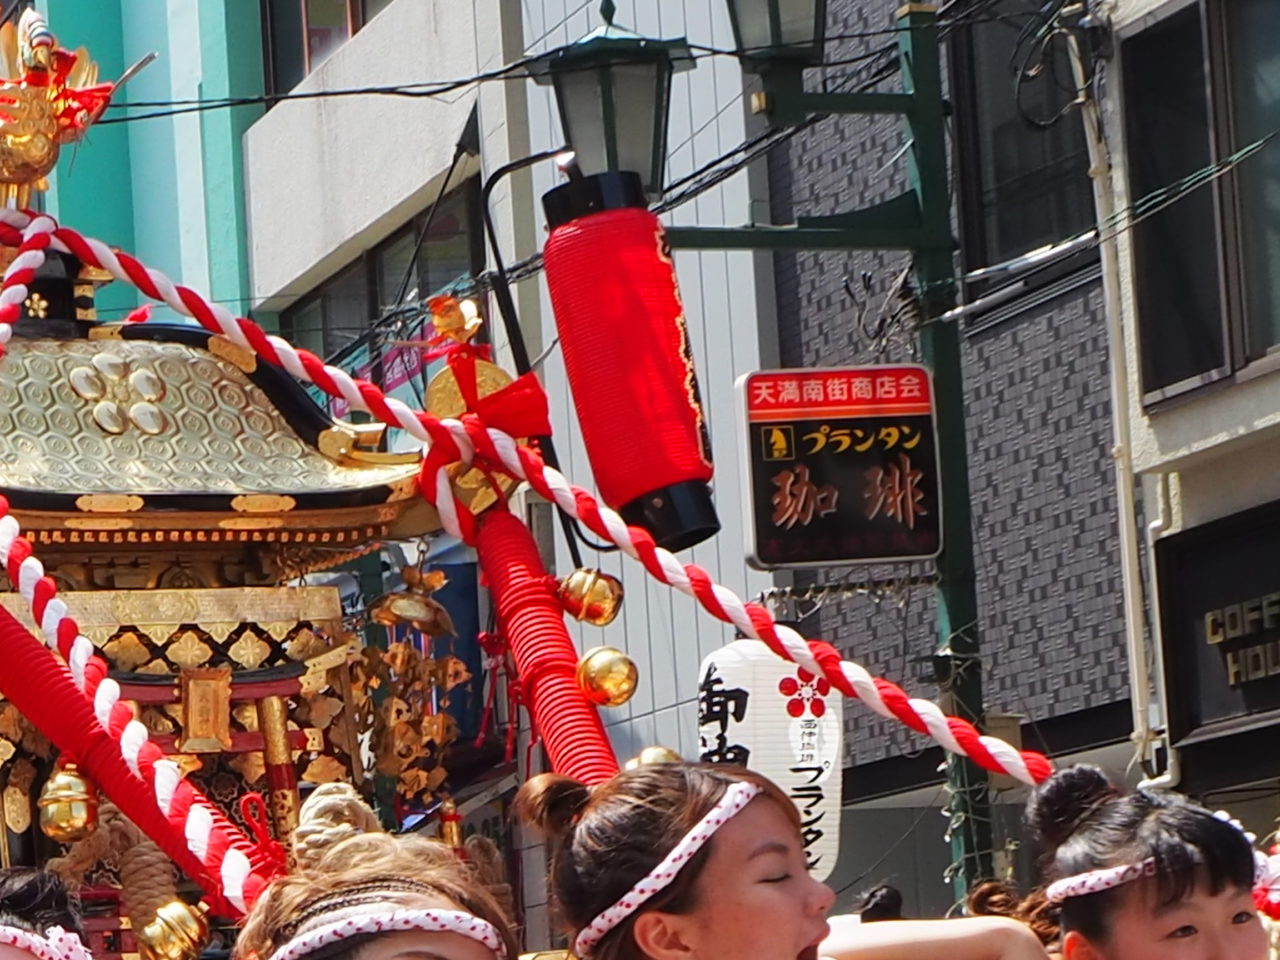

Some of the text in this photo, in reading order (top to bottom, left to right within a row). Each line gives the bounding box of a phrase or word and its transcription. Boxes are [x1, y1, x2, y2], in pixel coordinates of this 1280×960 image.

[753, 374, 922, 405] 天満南街商店会
[802, 424, 922, 455] プランタン
